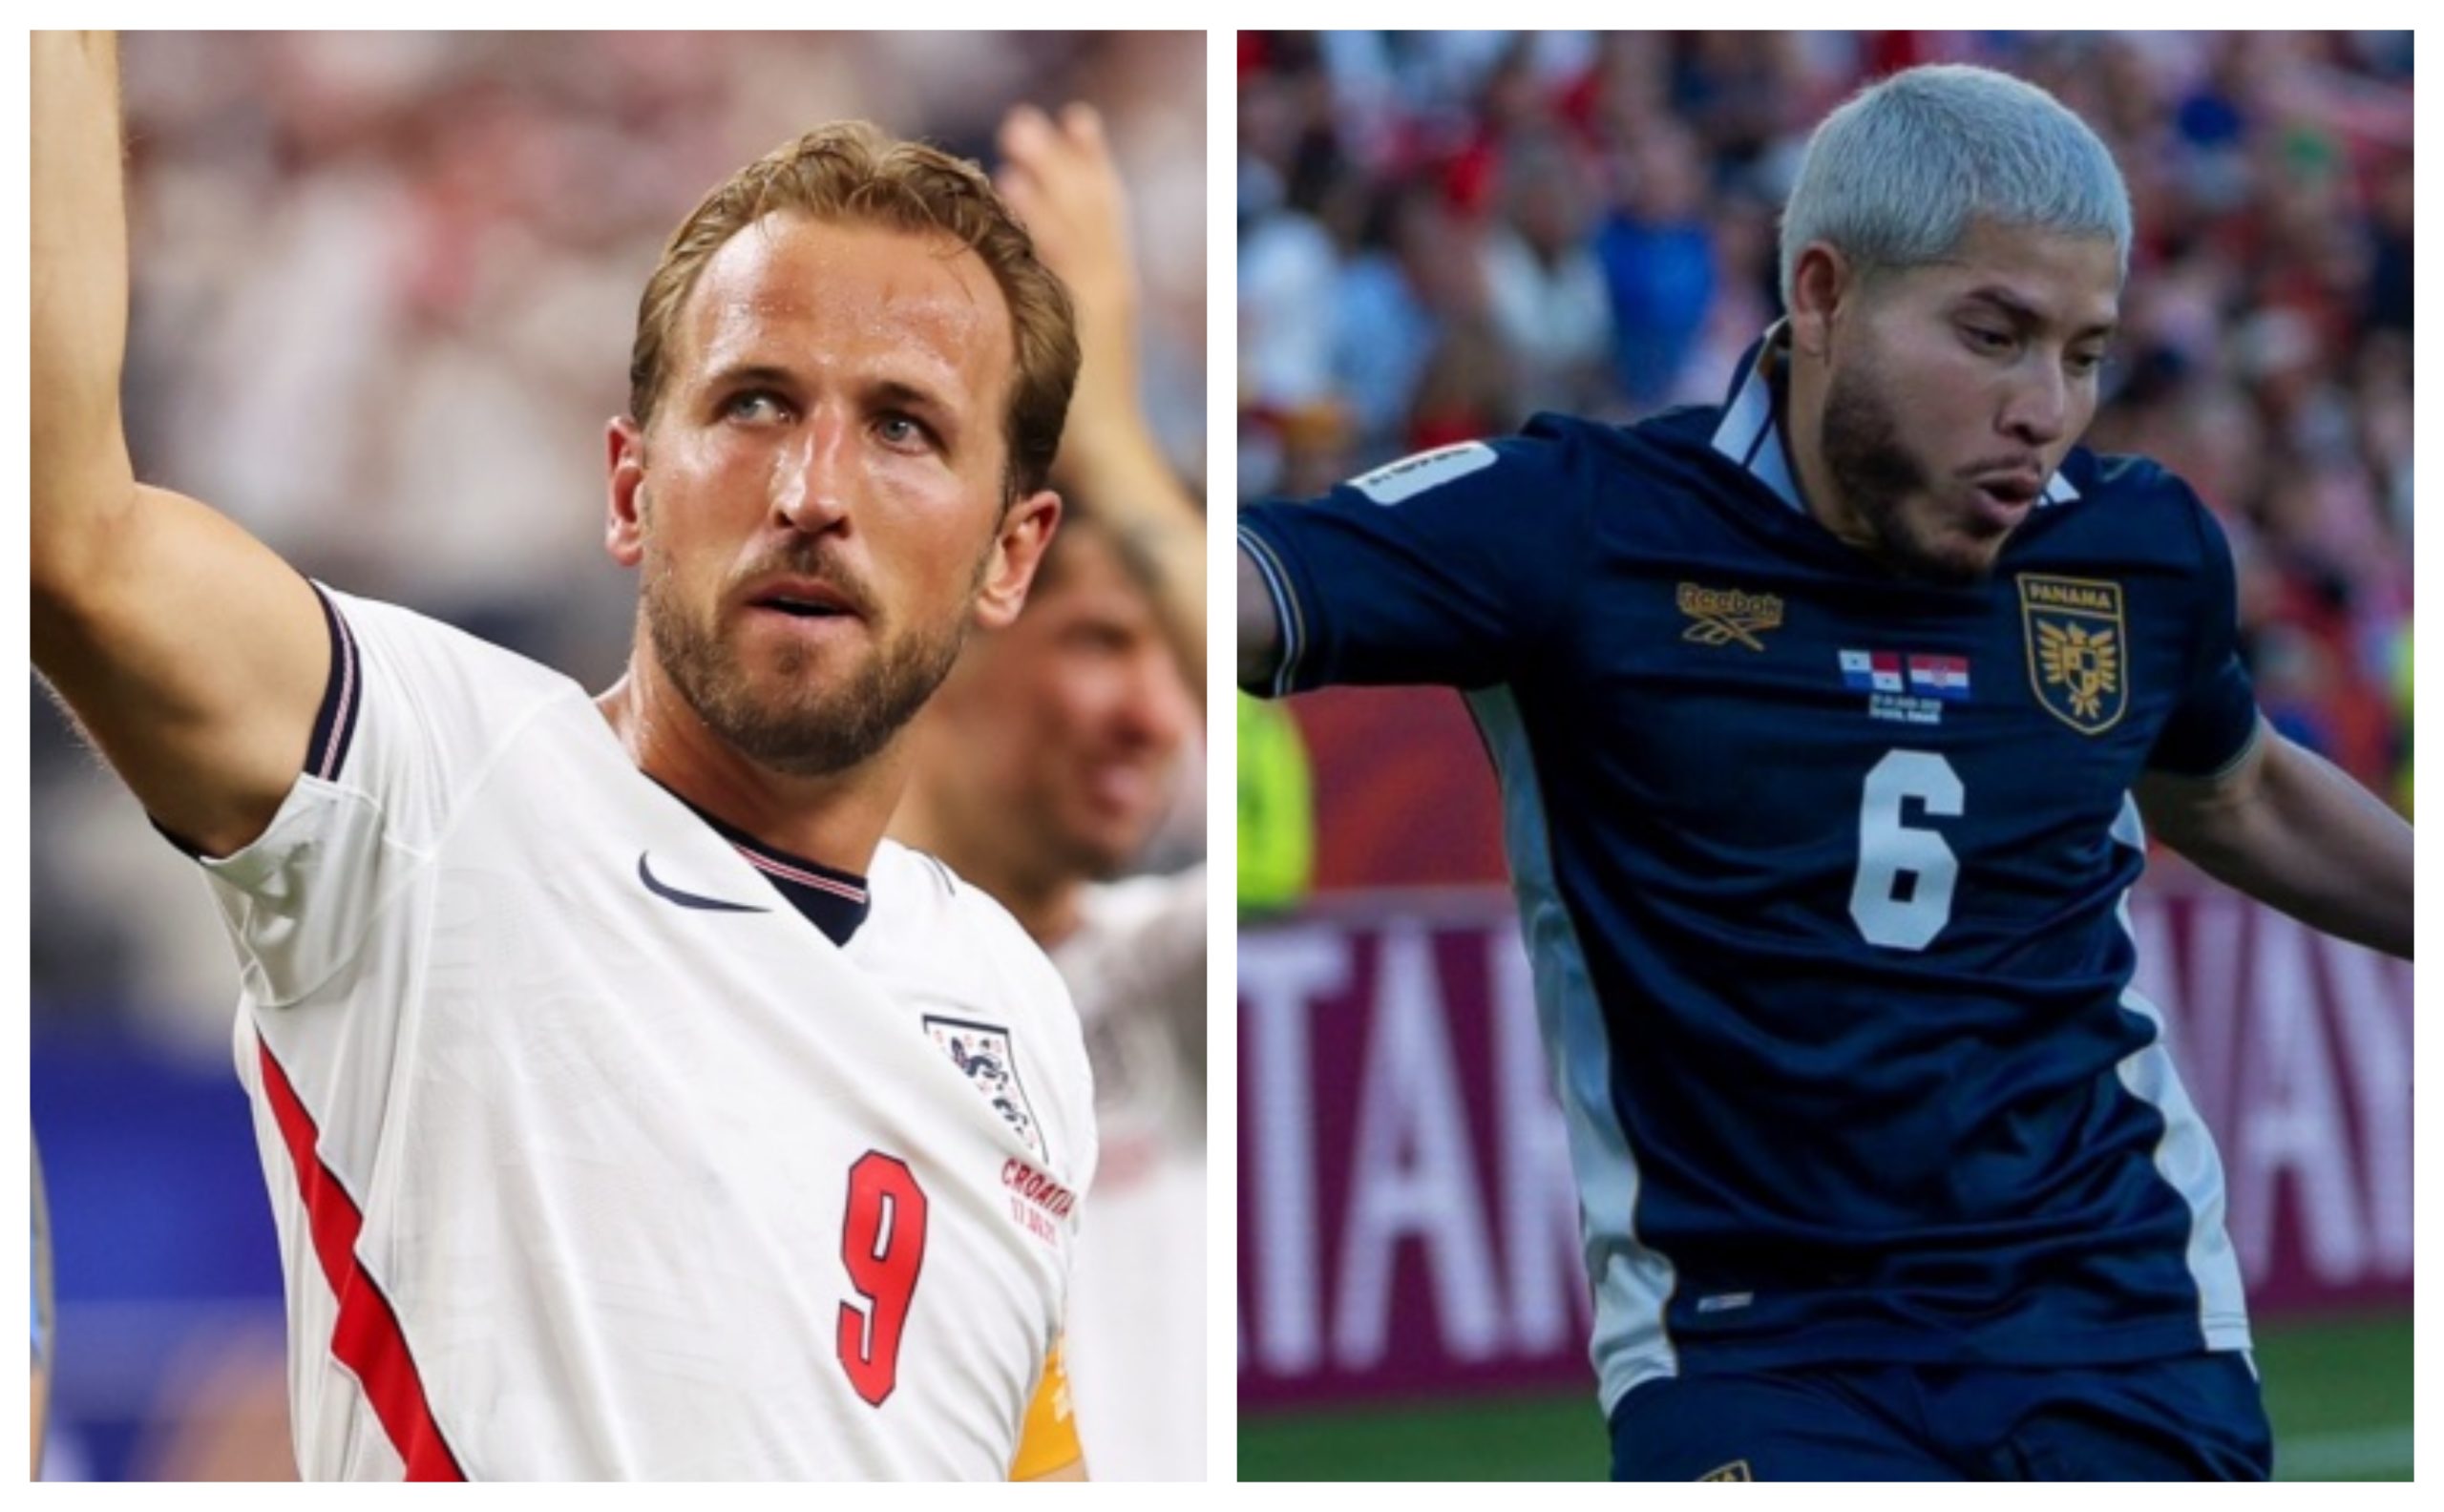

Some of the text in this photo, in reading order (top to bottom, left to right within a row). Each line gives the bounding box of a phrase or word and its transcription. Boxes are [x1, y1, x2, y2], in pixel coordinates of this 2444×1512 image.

[1677, 583, 1782, 622] Reebok
[2029, 582, 2113, 610] PANAMA
[1848, 748, 1965, 951] 6
[836, 1149, 927, 1409] 9
